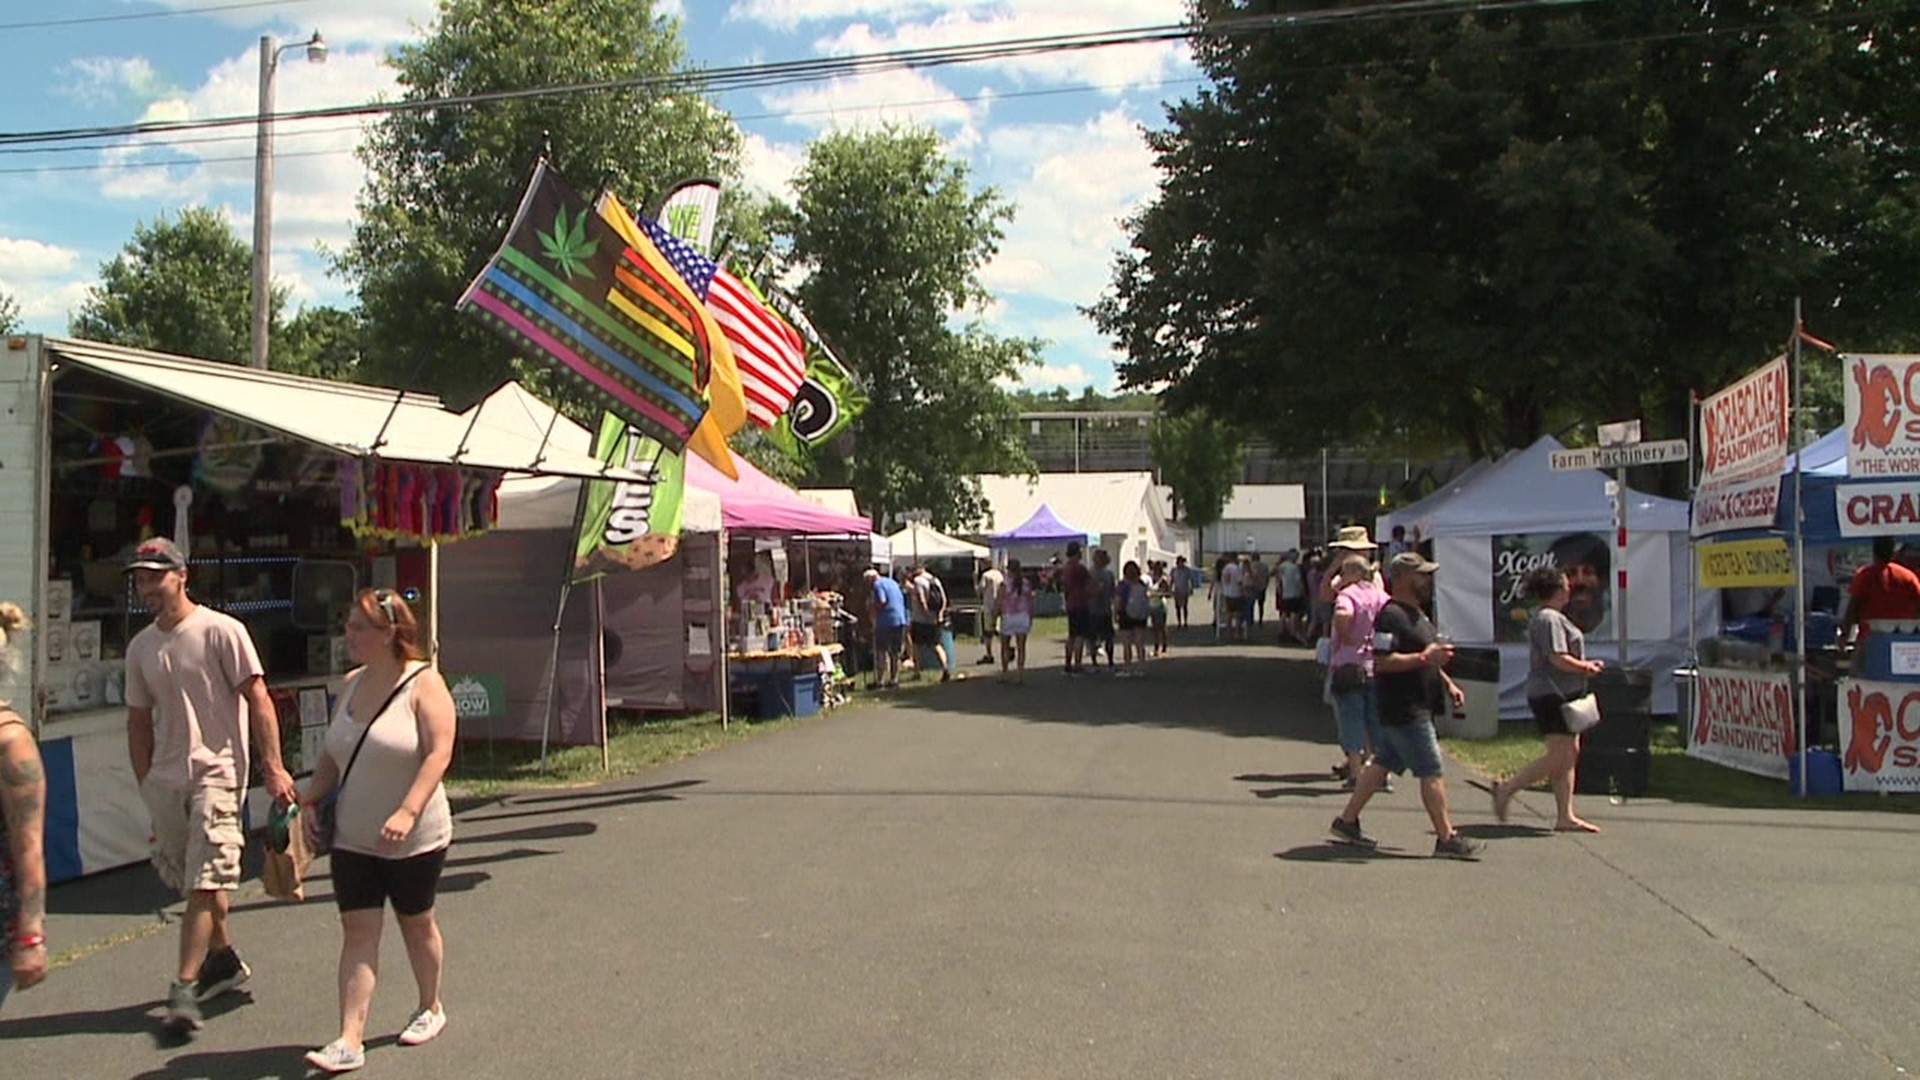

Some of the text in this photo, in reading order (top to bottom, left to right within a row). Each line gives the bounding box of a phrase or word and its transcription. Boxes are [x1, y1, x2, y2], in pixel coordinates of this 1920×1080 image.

[1715, 371, 1776, 444] CRABCAKE
[1551, 453, 1587, 469] Farm
[1592, 446, 1666, 465] Machinery
[1717, 426, 1776, 467] SANDWICH
[1733, 485, 1777, 518] CHEESE
[1708, 675, 1778, 731] CRABCAKE
[1710, 724, 1780, 757] SANDWICH
